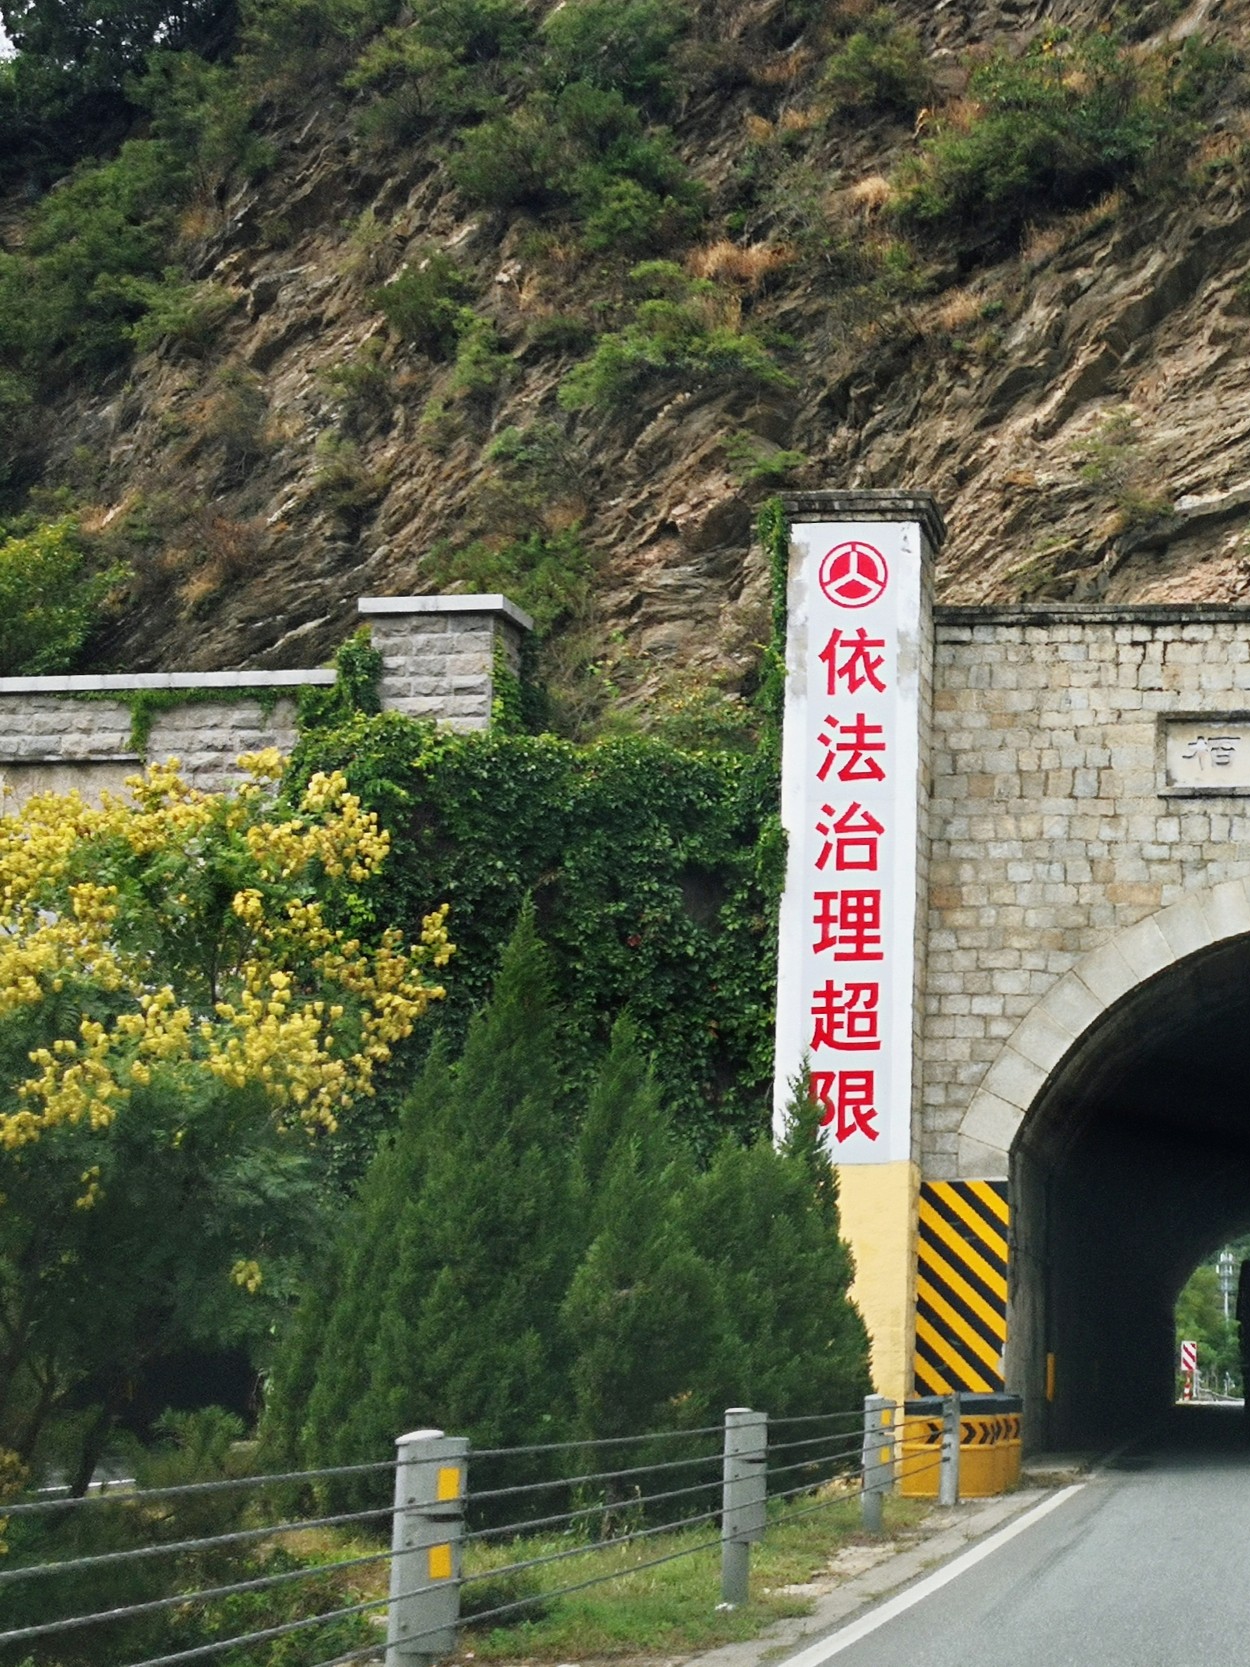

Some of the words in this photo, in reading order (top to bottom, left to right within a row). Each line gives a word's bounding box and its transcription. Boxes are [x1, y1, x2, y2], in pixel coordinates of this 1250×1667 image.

[809, 627, 887, 1144] 依法治理超限
